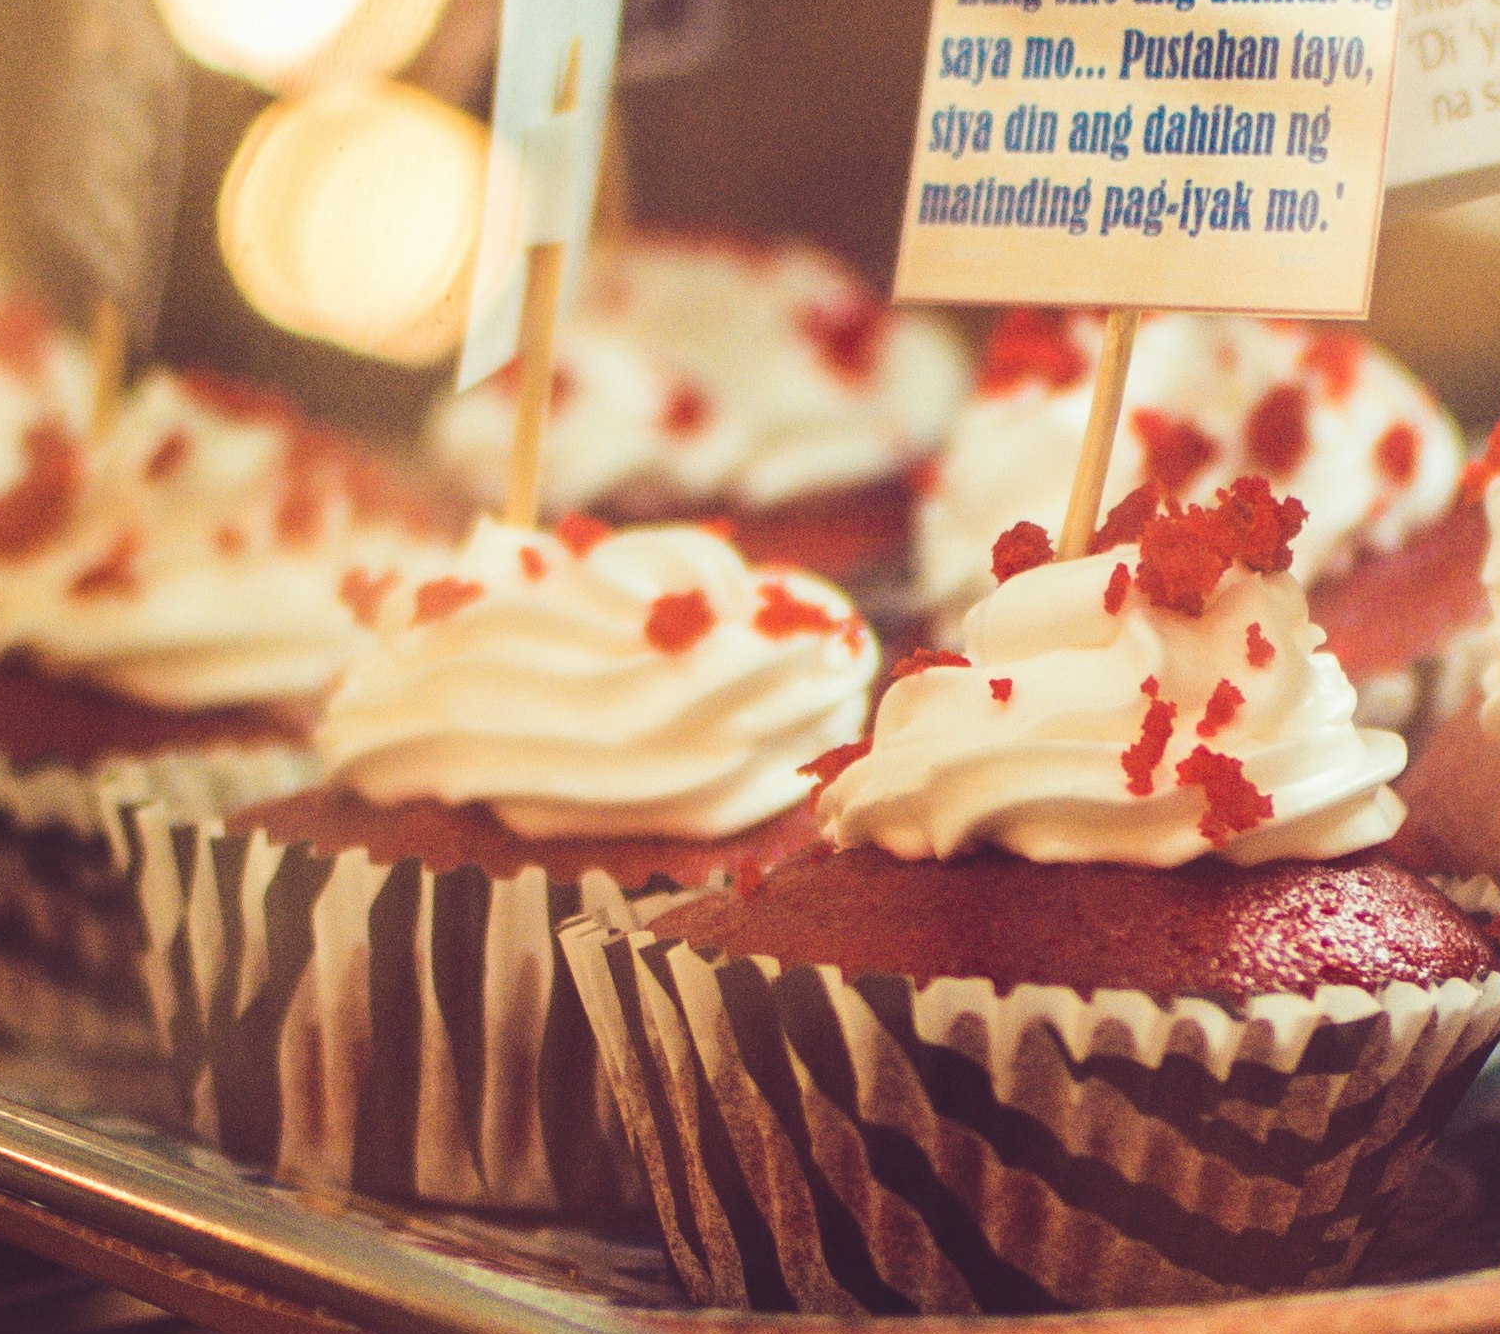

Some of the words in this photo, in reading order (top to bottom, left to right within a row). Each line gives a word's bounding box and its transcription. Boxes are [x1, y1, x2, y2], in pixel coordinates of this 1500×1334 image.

[939, 35, 1012, 85] saya
[1022, 36, 1106, 80] mo...
[1119, 28, 1280, 81] Pustahan
[1290, 29, 1374, 87] tayo,
[928, 102, 994, 160] siya
[1004, 103, 1058, 155] din
[1068, 103, 1133, 161] ang
[1142, 103, 1276, 156] dahilan
[1285, 104, 1331, 163] ng
[1431, 88, 1472, 125] na
[917, 177, 1092, 236] matinding
[1099, 178, 1253, 238] pag-iyak
